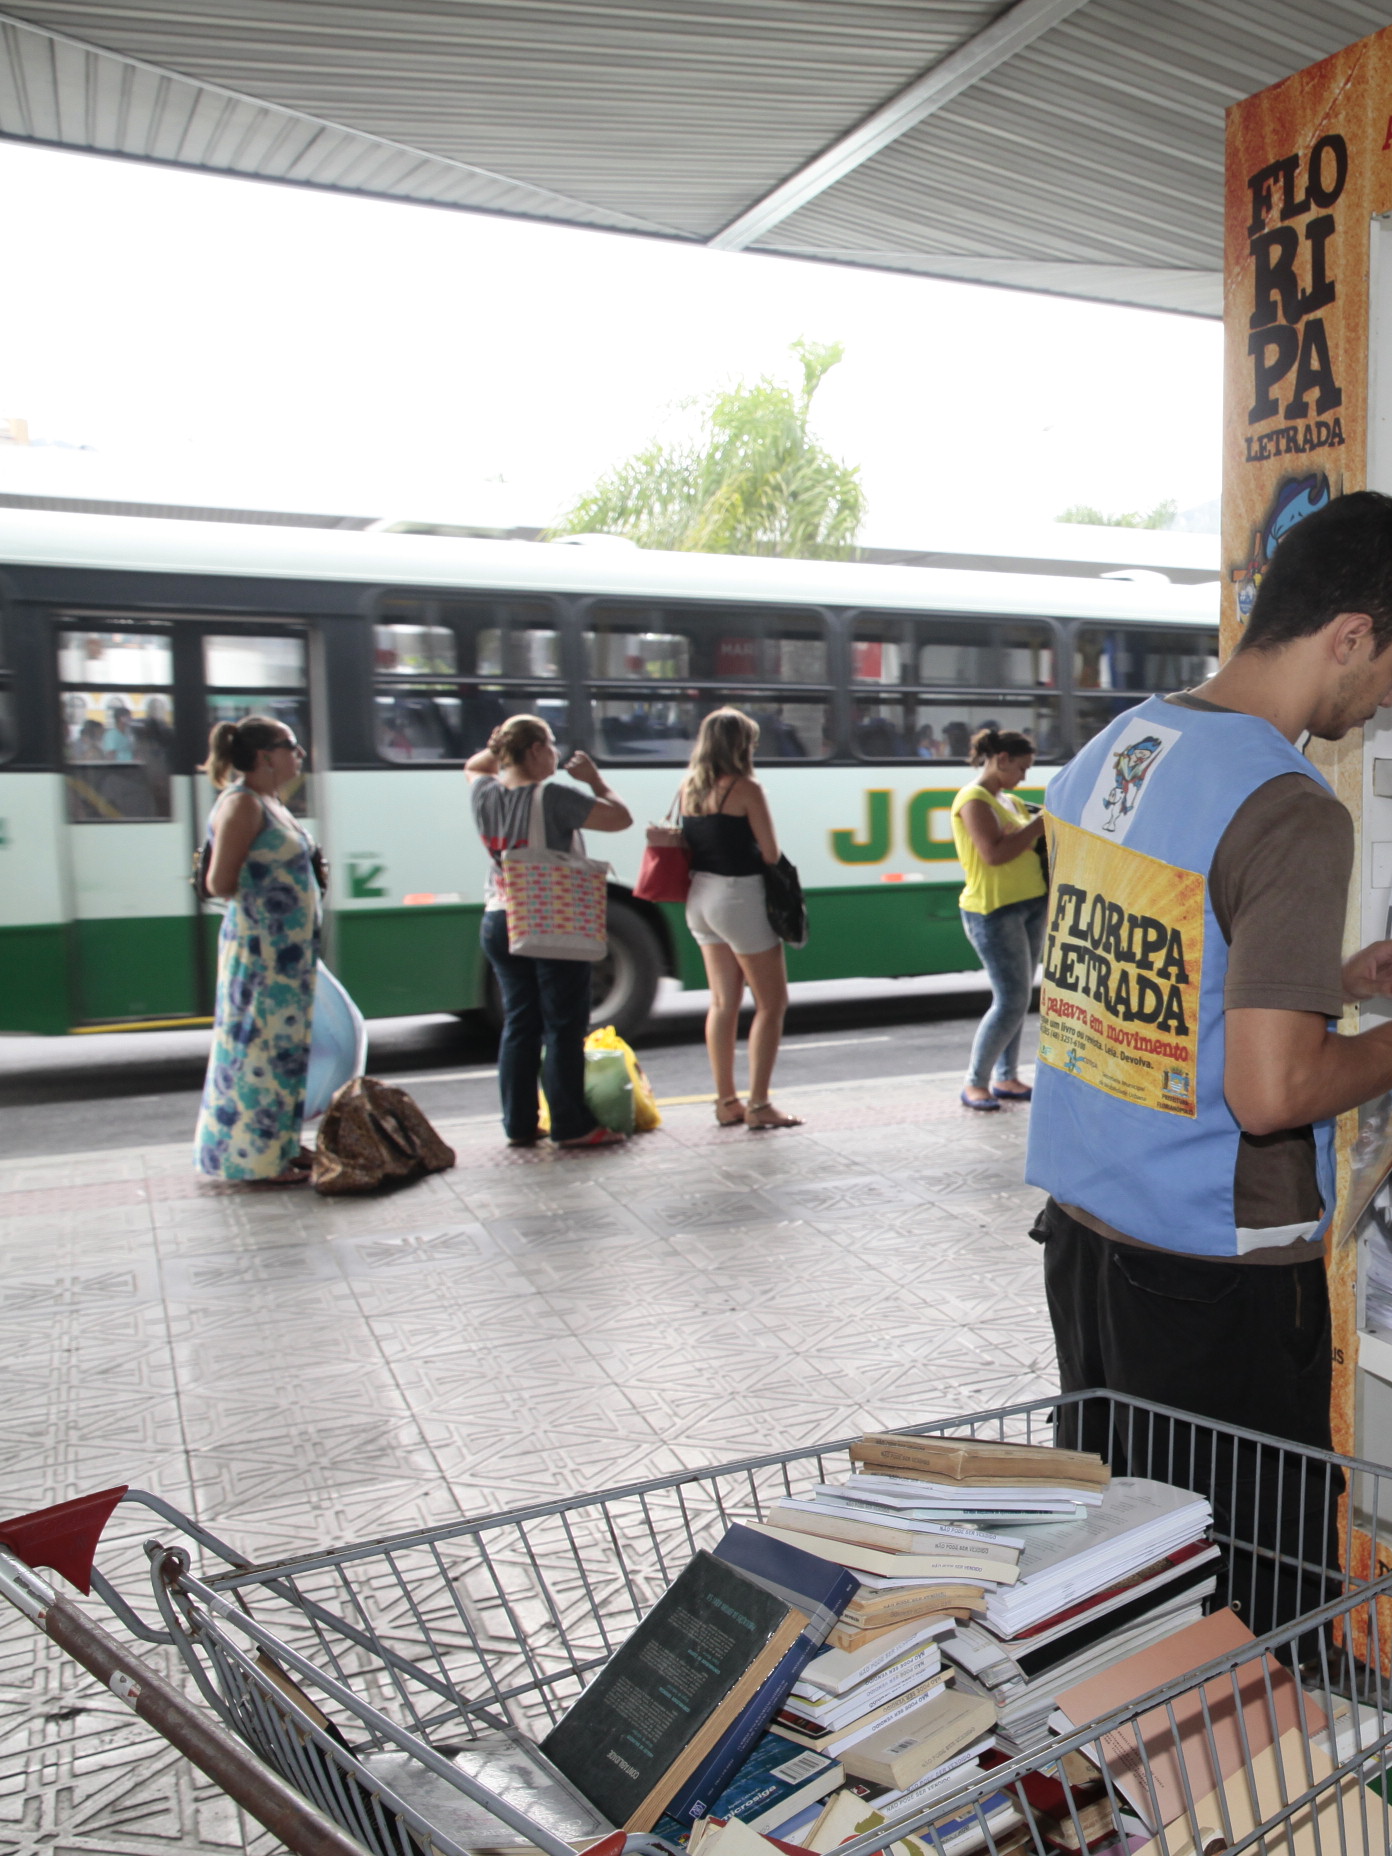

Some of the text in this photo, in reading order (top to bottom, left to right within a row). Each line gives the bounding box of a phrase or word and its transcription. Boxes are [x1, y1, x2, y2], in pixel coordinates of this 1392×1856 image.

[1248, 133, 1347, 241] FLO
[1248, 215, 1335, 329] RI
[1248, 318, 1342, 426] PA
[1245, 417, 1345, 463] LETRADA
[829, 787, 1046, 865] JO
[1052, 883, 1189, 984] FLORIPA
[1044, 935, 1189, 1036] LETRADA
[1046, 996, 1189, 1062] palavra em movimento
